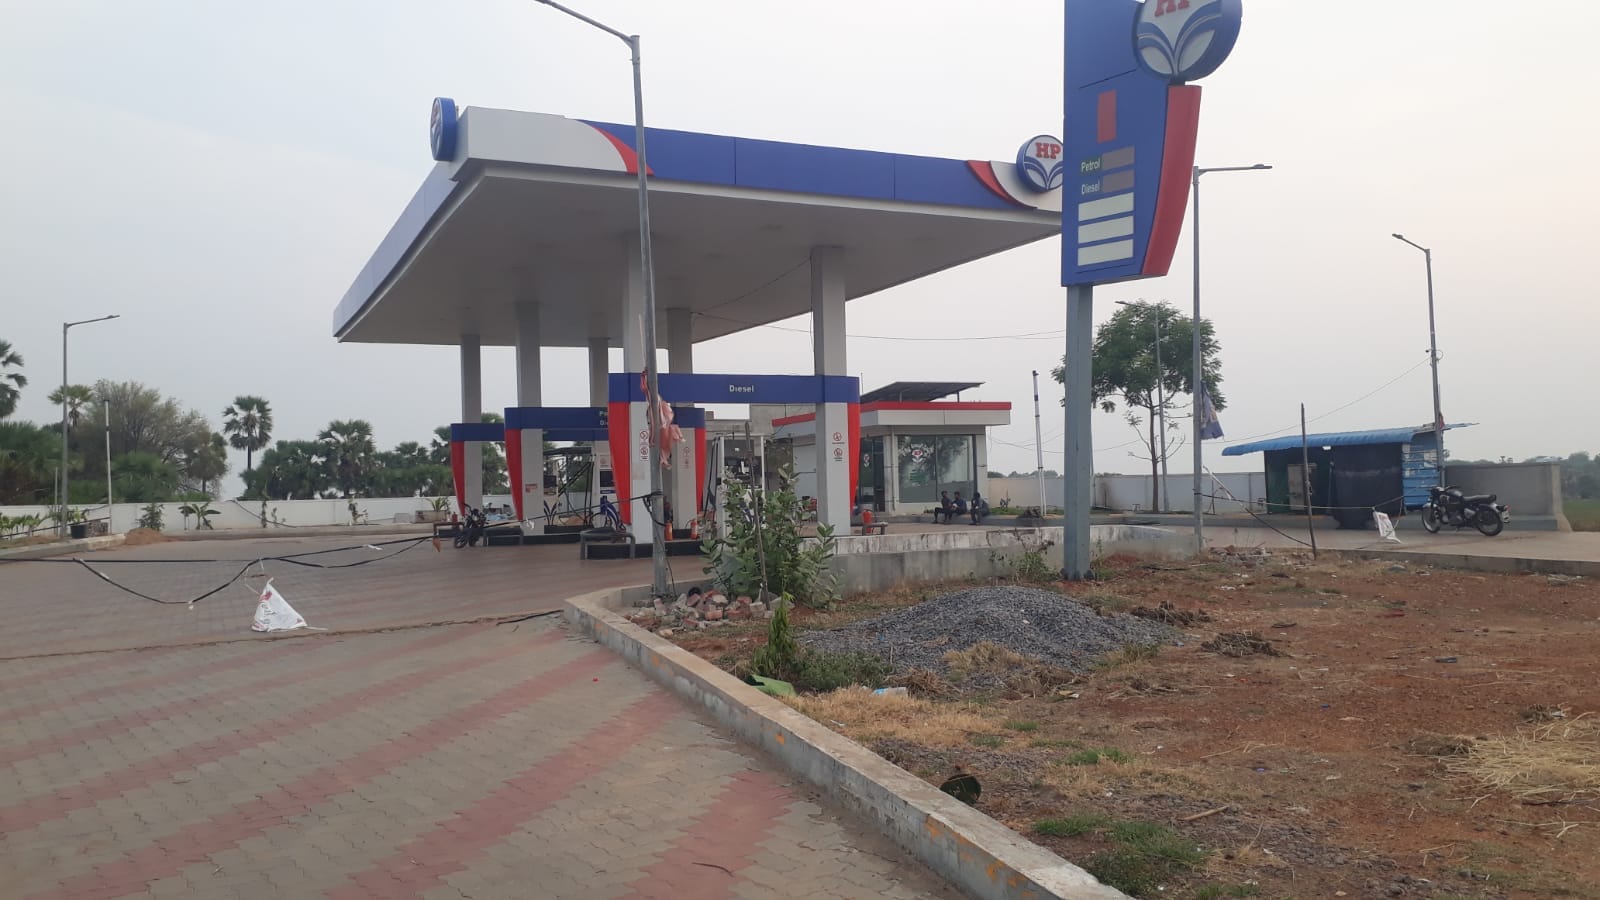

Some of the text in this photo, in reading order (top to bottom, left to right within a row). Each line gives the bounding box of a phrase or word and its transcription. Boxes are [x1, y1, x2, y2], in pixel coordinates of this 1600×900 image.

[1035, 142, 1061, 159] HP
[1081, 157, 1101, 172] Petrol
[1081, 178, 1100, 195] Diesel
[729, 384, 755, 393] Diesel
